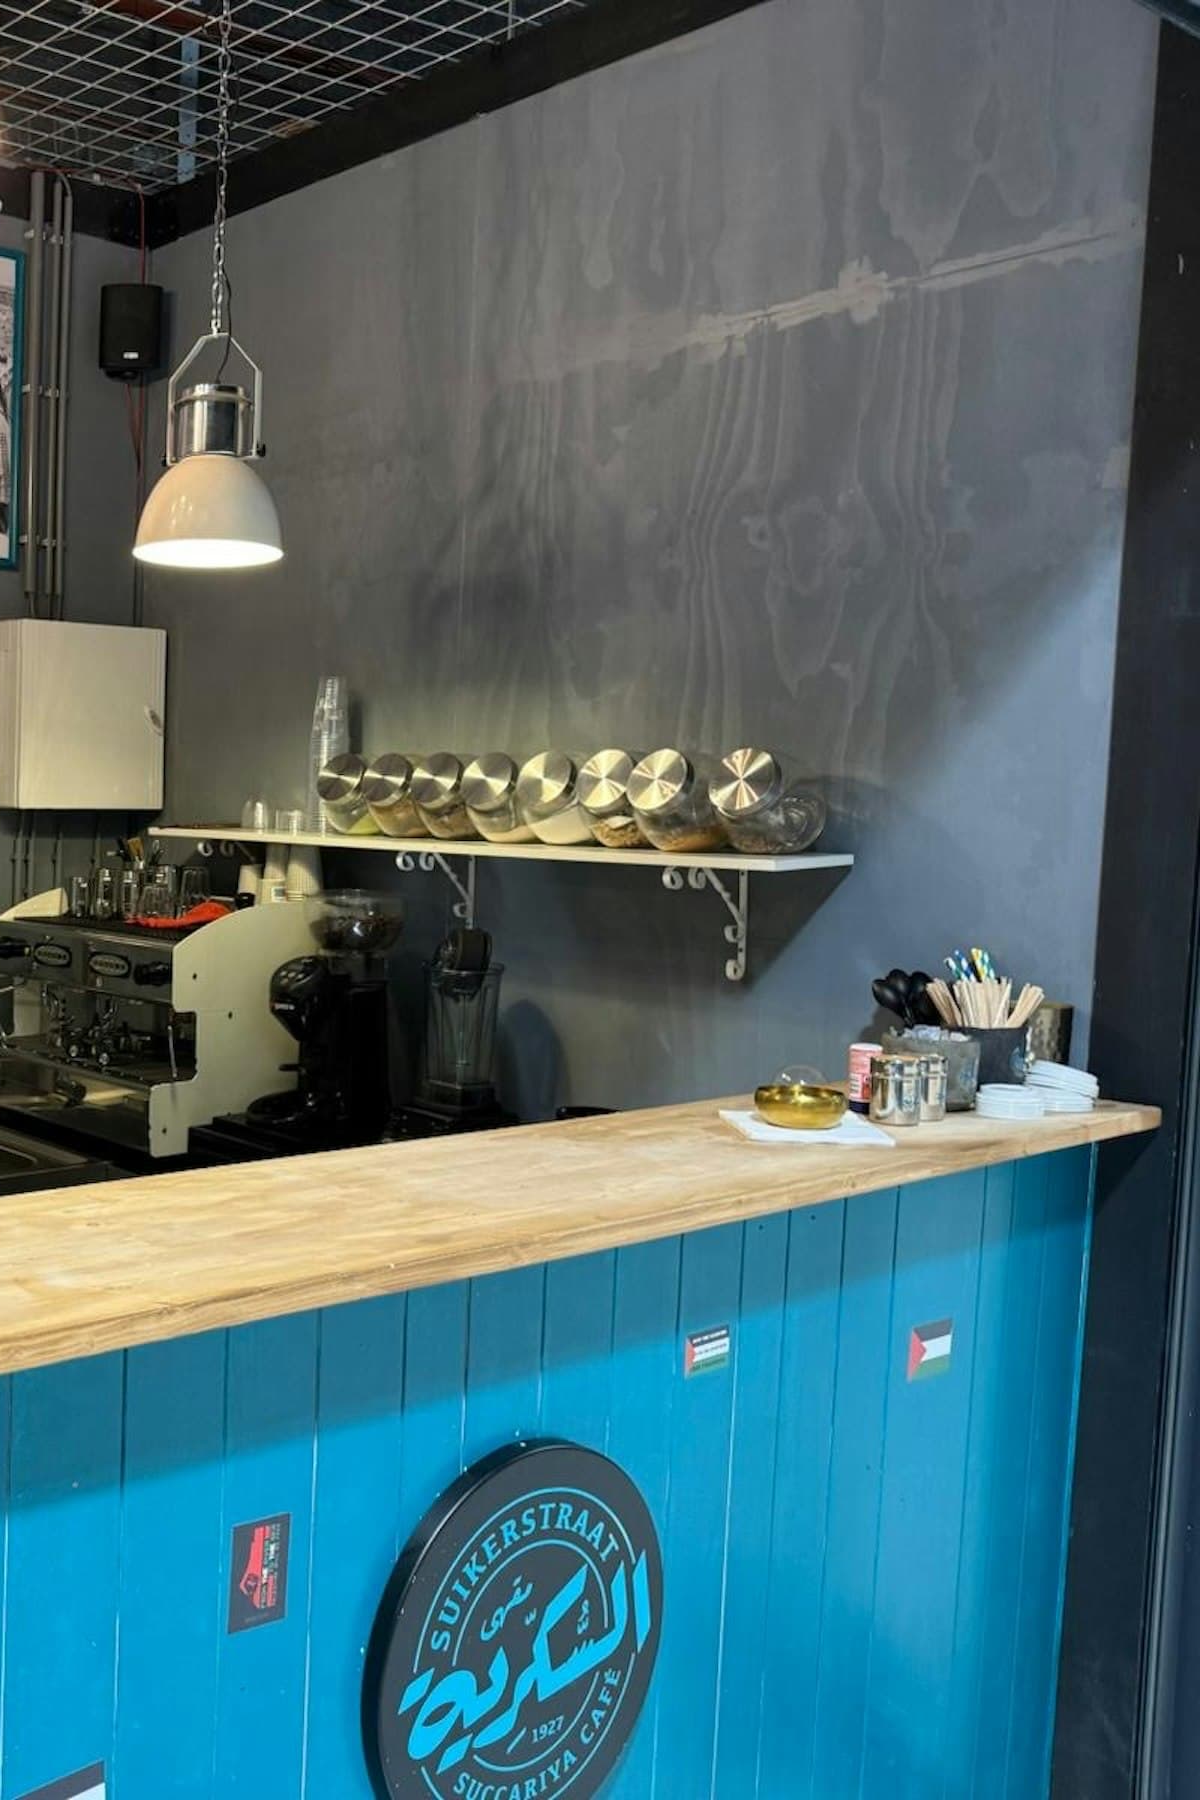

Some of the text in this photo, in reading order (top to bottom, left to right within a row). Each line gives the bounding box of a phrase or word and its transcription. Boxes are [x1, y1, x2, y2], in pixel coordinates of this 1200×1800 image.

[431, 1503, 620, 1652] SUIKERSTRAAT
[530, 1715, 565, 1744] 1927
[453, 1749, 577, 1800] SUCCARIYA
